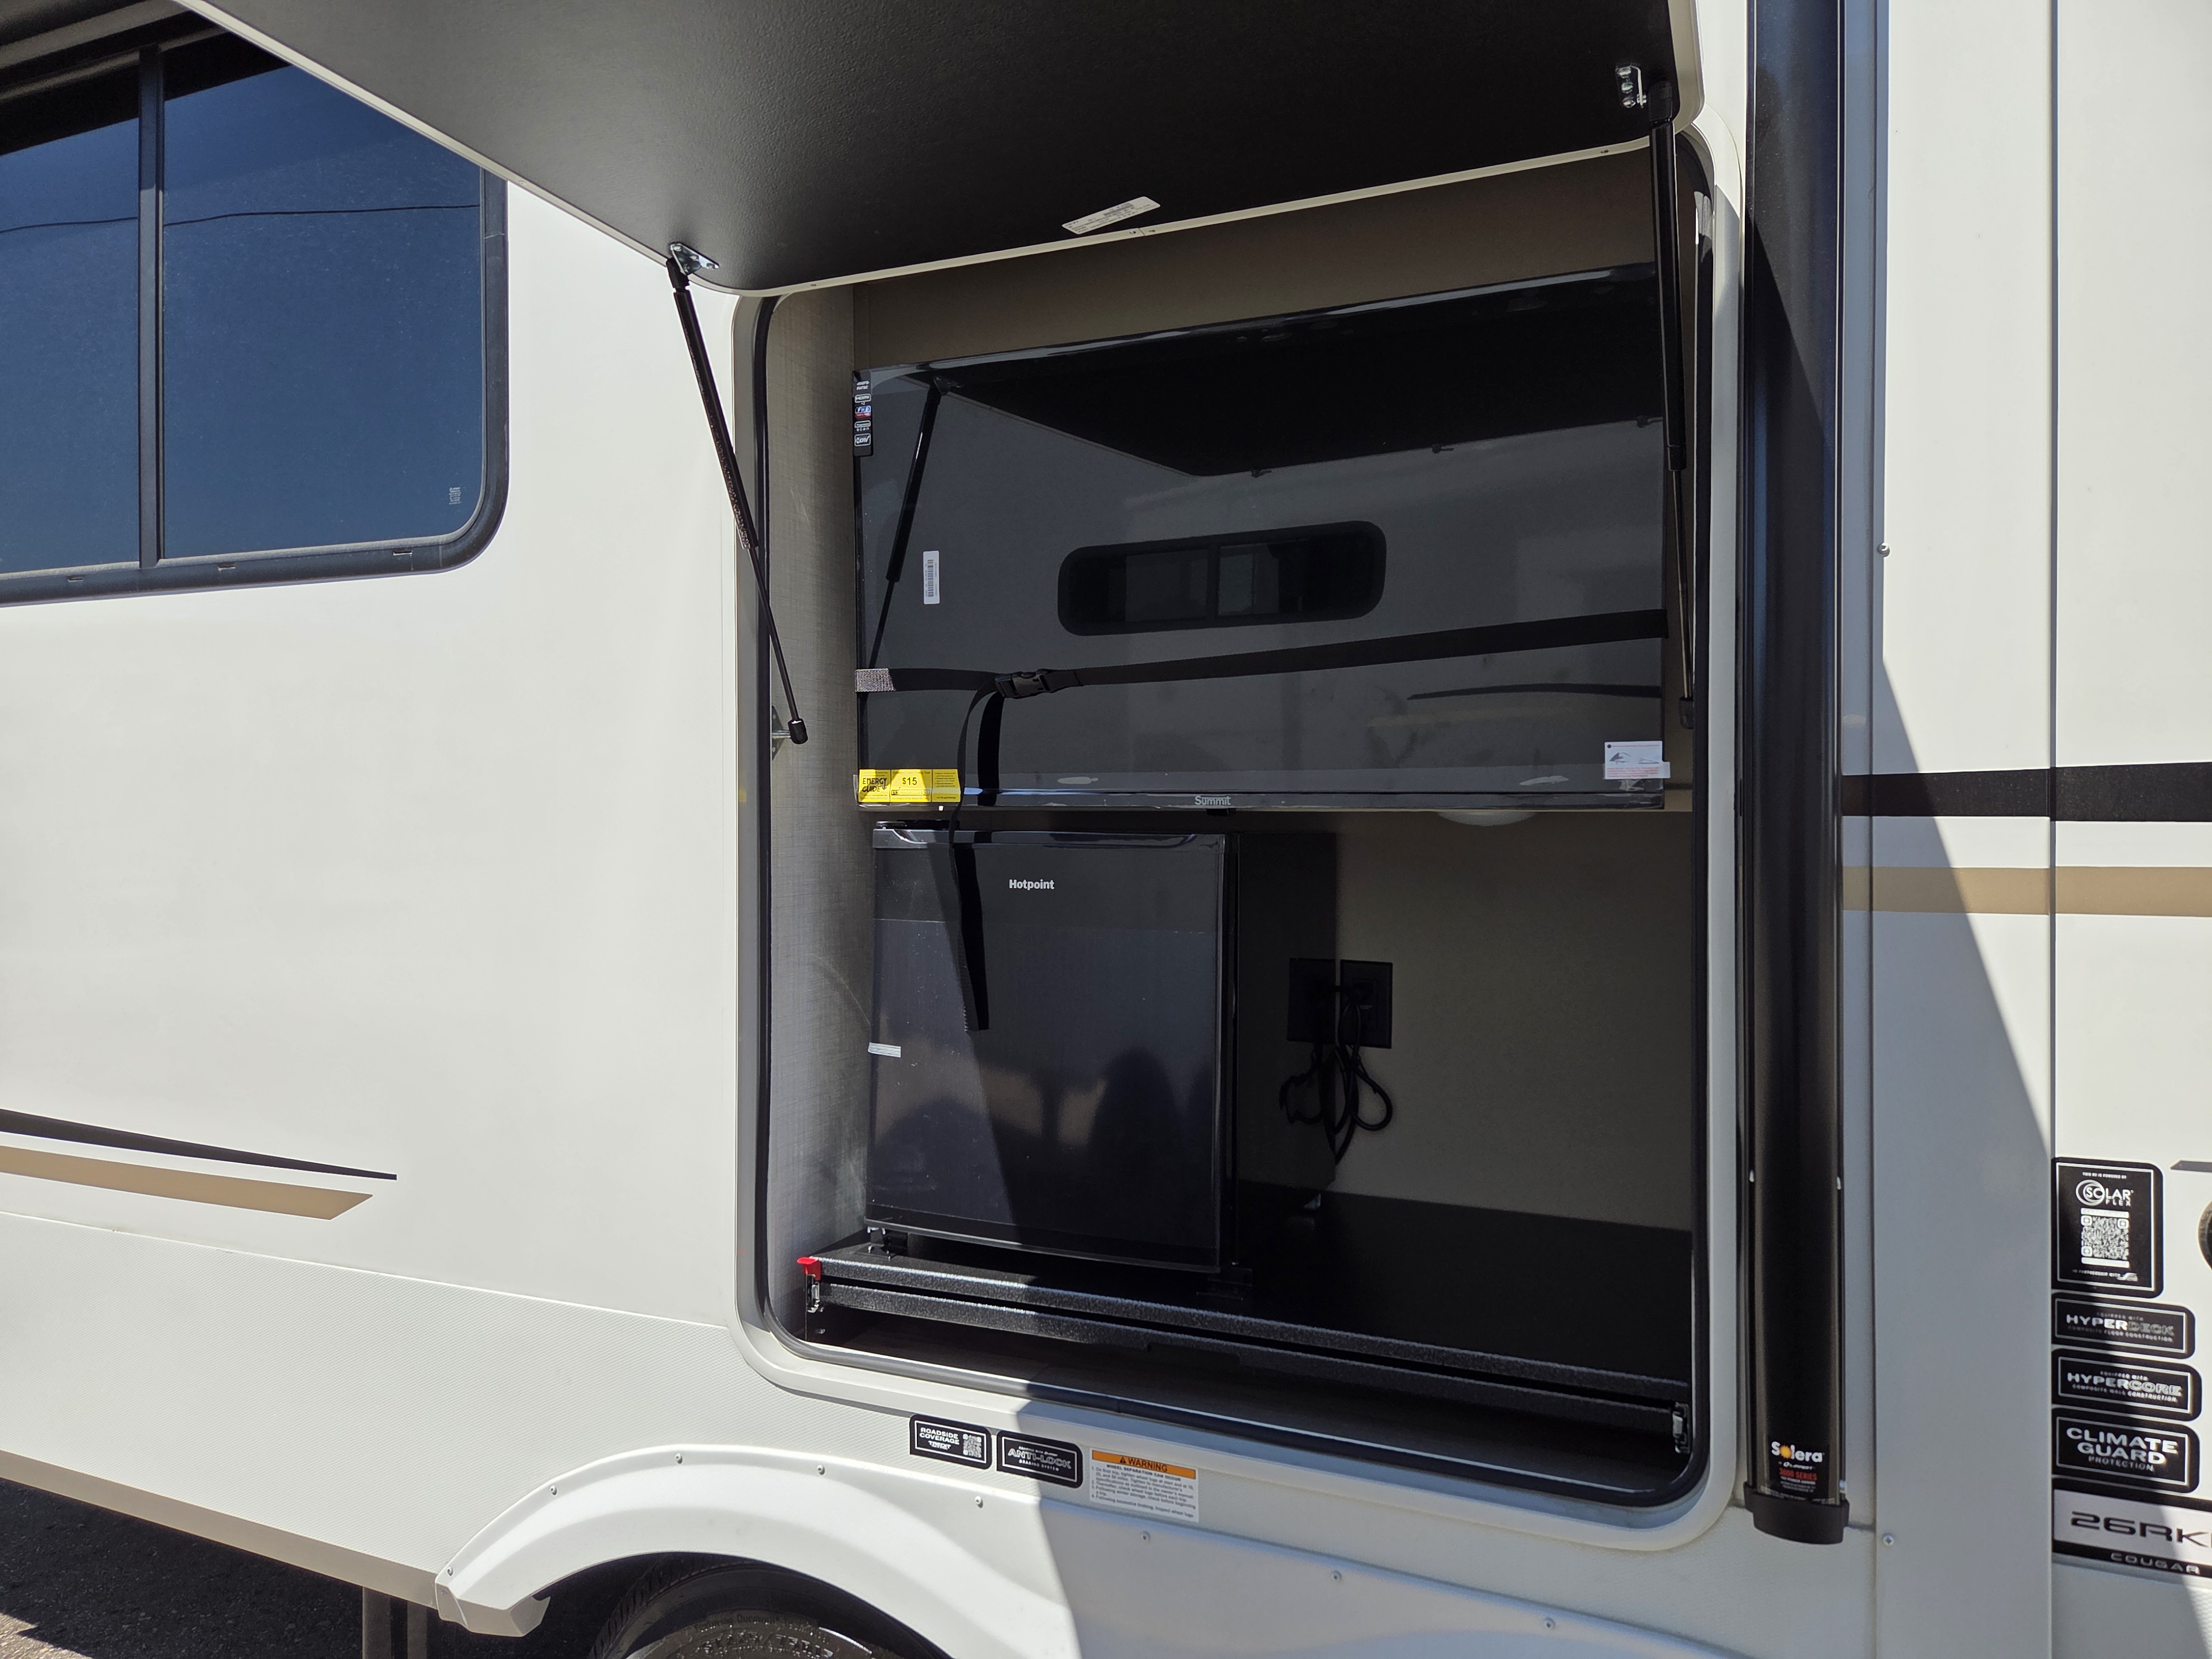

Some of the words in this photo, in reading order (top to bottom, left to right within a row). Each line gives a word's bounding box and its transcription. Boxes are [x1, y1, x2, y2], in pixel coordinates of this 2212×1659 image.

[902, 777, 917, 785] $15
[1194, 795, 1231, 805] Summit
[1009, 879, 1055, 891] Hotpoint
[2086, 1187, 2131, 1201] SOLAR
[2066, 1314, 2174, 1336] HYPERDECK
[2125, 1332, 2173, 1343] CONSTRUCTION
[2067, 1372, 2182, 1396] HYPERCORE
[2127, 1391, 2177, 1402] CONSTRUCTION
[919, 1433, 959, 1444] COVERAGE
[920, 1427, 958, 1439] ROADSIDE
[2066, 1427, 2178, 1454] CLIMATE
[1008, 1448, 1071, 1469] ANTI-LOCK
[1771, 1441, 1822, 1463] Solera
[2077, 1442, 2166, 1464] GUARD
[1128, 1457, 1168, 1472] WARNING
[2088, 1455, 2154, 1472] PROTECTION
[1796, 1471, 1817, 1480] SERIES
[2070, 1510, 2212, 1548] 26RK
[2111, 1552, 2200, 1575] COUGAR
